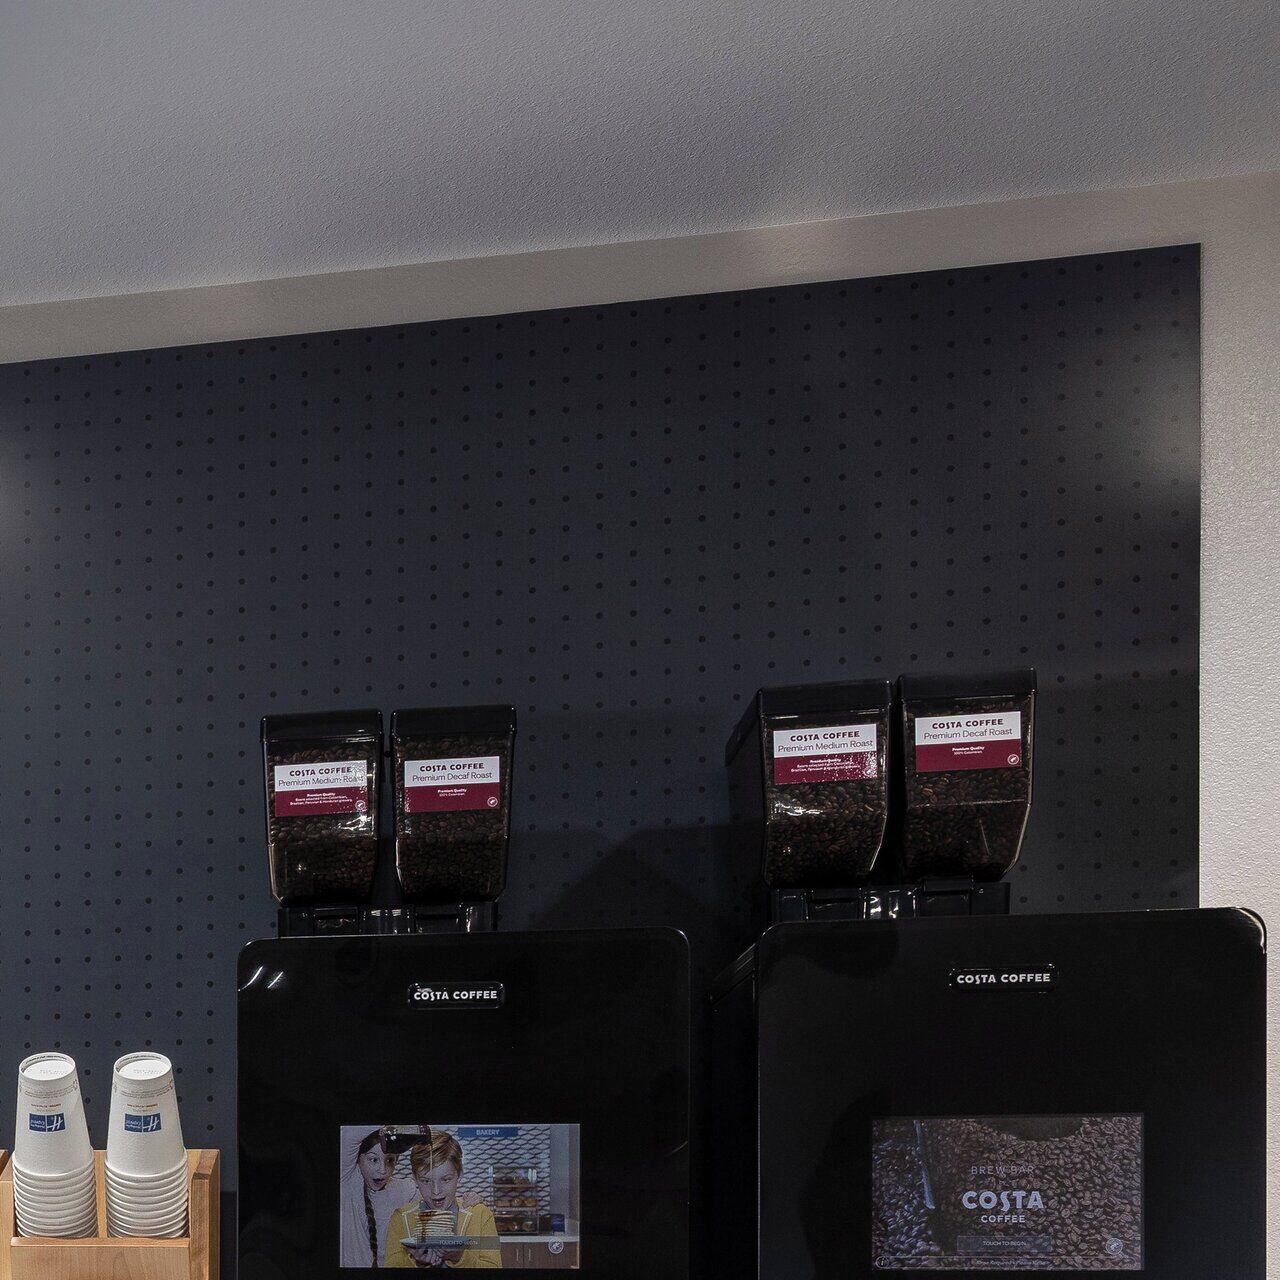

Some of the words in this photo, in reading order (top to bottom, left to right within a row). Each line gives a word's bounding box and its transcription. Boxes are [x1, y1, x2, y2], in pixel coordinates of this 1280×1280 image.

[932, 721, 962, 730] COSTA
[965, 718, 1004, 727] COFFEE
[790, 734, 819, 742] COSTA
[822, 731, 860, 739] COFFEE
[924, 732, 960, 740] Premium
[962, 729, 987, 738] Decaf
[989, 728, 1013, 736] Roast
[778, 745, 814, 753] Premium
[815, 742, 848, 750] Medium
[850, 740, 873, 748] Roast
[289, 769, 316, 777] COSTA
[319, 766, 352, 775] COFFEE
[420, 764, 447, 772] COSTA
[450, 762, 485, 771] COFFEE
[278, 779, 311, 787] Premium
[312, 777, 341, 785] Medium
[412, 774, 445, 782] Premium
[447, 772, 469, 780] Decaf
[471, 771, 492, 779] Roast
[957, 974, 996, 985] COSTA
[1000, 973, 1051, 983] COFFEE
[413, 990, 449, 1001] COSTA
[453, 990, 498, 1000] COFFEE
[476, 1128, 500, 1136] BAKERY
[971, 1166, 1005, 1175] BREW
[962, 1190, 1044, 1212] COSTA
[981, 1214, 1026, 1223] COFFEE
